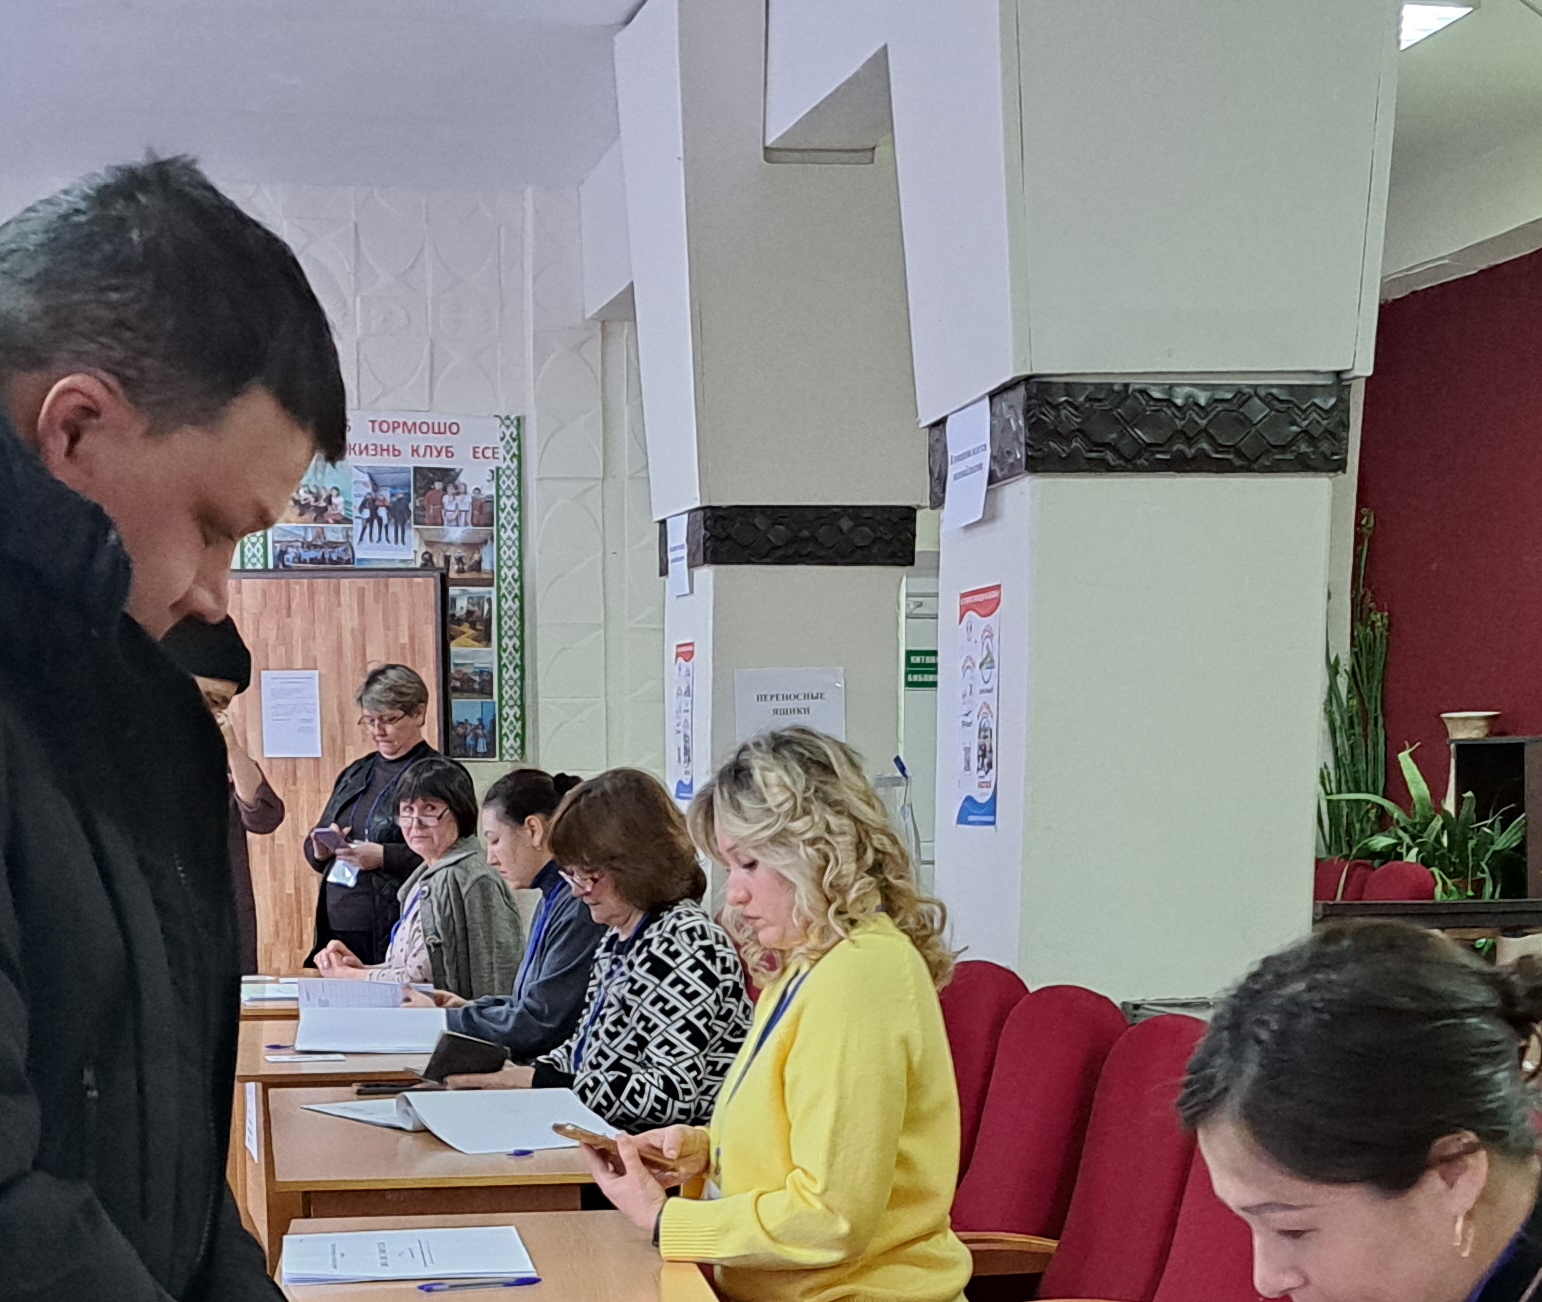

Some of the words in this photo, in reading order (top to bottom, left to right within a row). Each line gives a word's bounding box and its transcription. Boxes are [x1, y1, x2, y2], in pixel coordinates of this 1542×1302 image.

[368, 419, 461, 436] ТОРМОШО
[410, 444, 455, 459] КЛУБ
[472, 446, 500, 460] ЕСЕ
